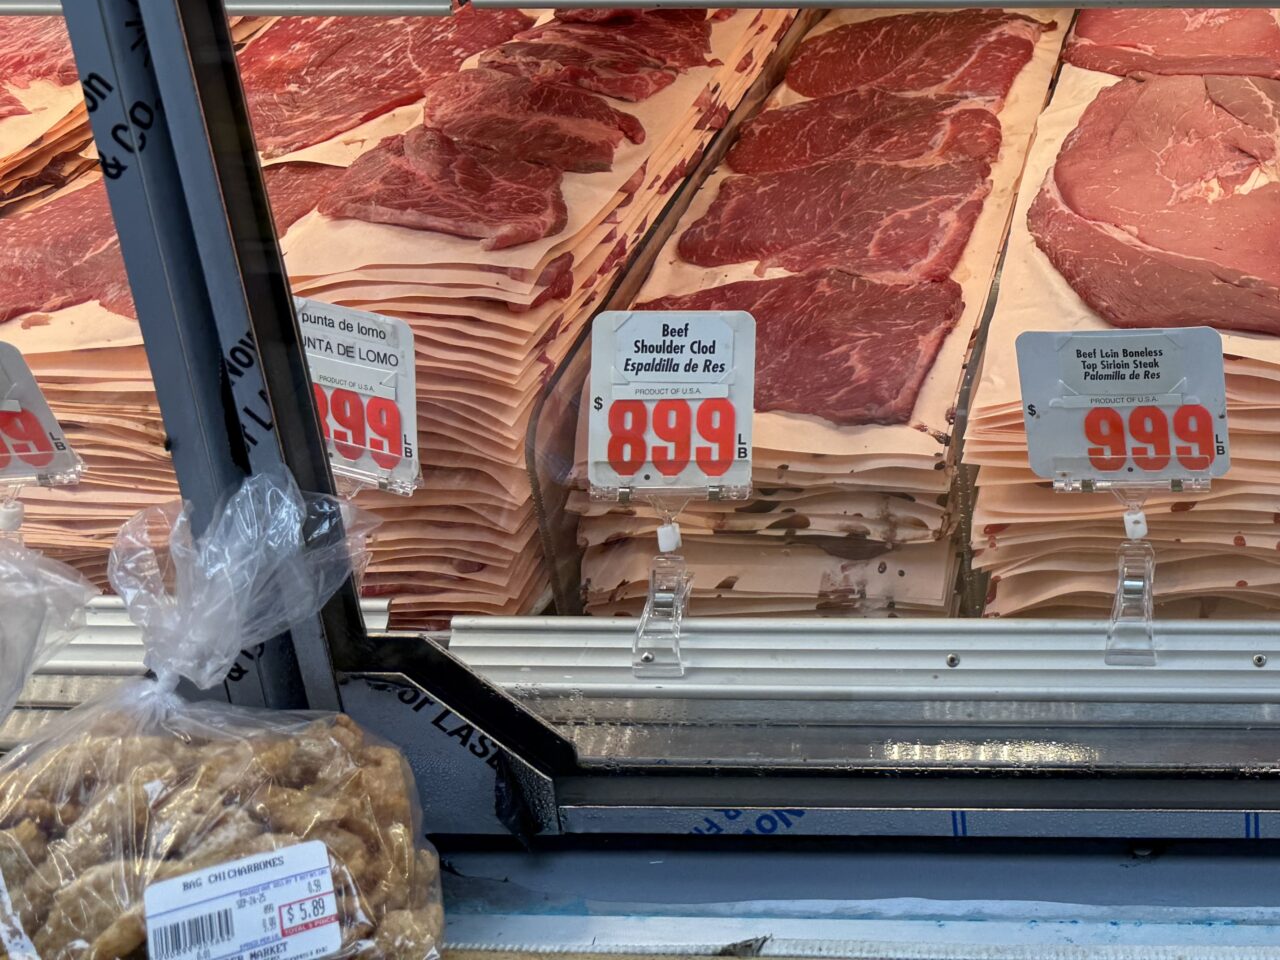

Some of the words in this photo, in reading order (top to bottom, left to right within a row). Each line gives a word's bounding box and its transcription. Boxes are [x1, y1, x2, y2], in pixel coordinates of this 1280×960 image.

[302, 312, 334, 328] punta
[339, 319, 353, 332] de
[358, 322, 386, 339] lomo
[662, 323, 689, 337] Beef
[634, 340, 685, 354] Shoulder
[690, 340, 715, 354] Clod
[1076, 349, 1097, 358] Beef
[1100, 349, 1119, 358] Loin
[1122, 348, 1163, 357] Boneless
[338, 343, 355, 358] DE
[359, 348, 398, 367] LOMO
[624, 358, 679, 375] Espaldilla
[684, 359, 698, 372] de
[703, 359, 725, 373] Res
[1081, 360, 1098, 372] Top
[1101, 360, 1129, 370] Sirloin
[1134, 359, 1159, 368] Steak
[319, 375, 347, 386] PRODUCT
[1084, 371, 1126, 381] Palomilla
[1129, 370, 1140, 380] de
[1144, 370, 1160, 379] Res
[594, 396, 603, 411] $
[1028, 404, 1037, 416] $
[182, 880, 202, 891] BAG
[208, 856, 284, 884] CHICHARRONES
[287, 905, 294, 923] $
[300, 897, 325, 920] 5.89
[250, 942, 288, 960] MARKET
